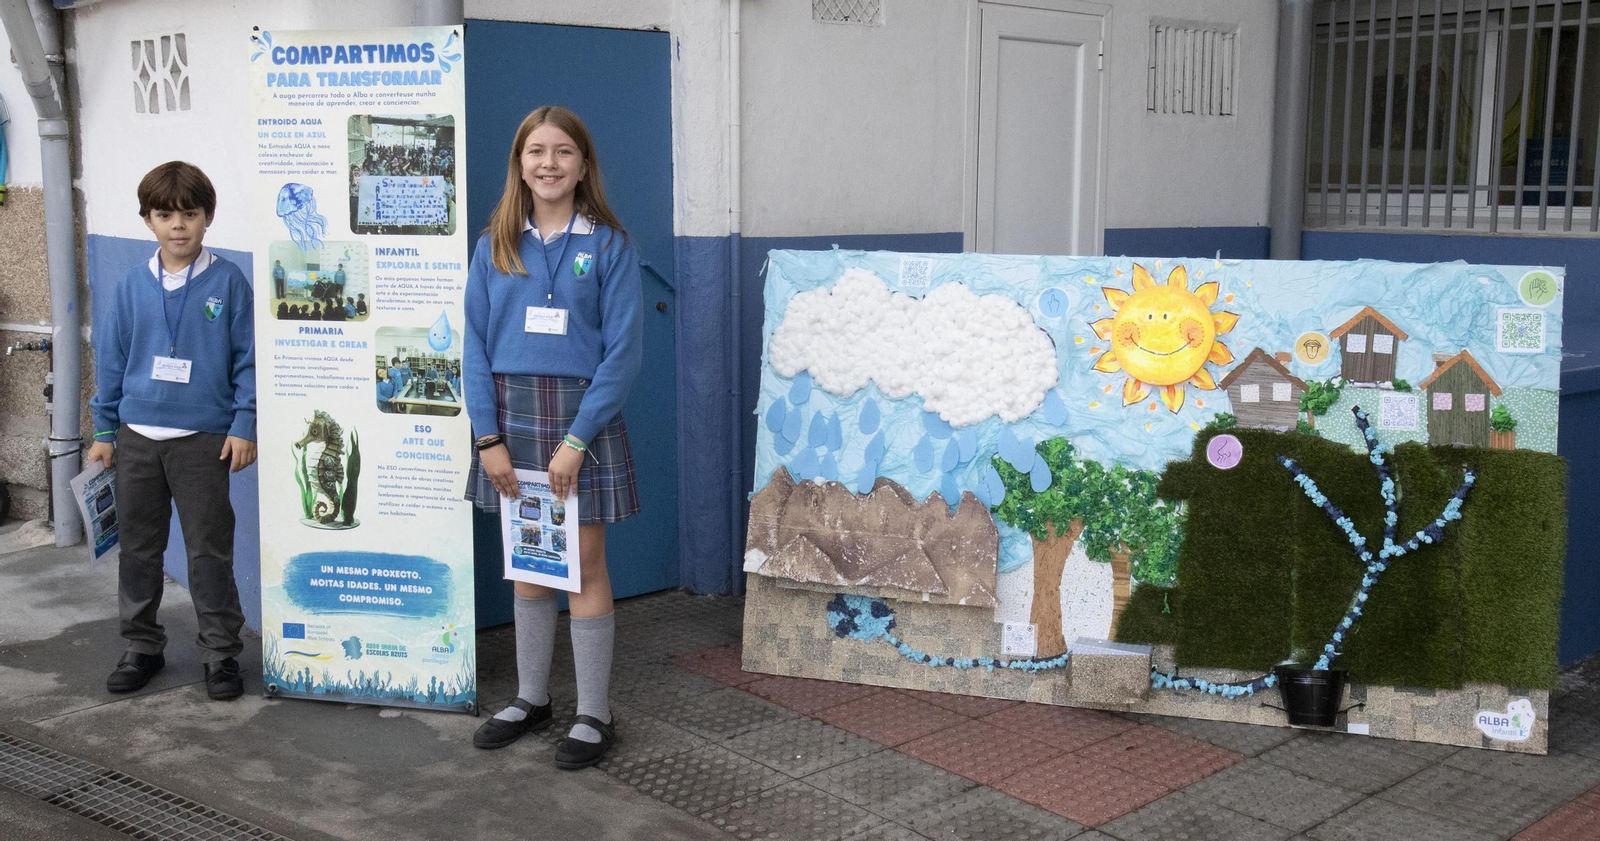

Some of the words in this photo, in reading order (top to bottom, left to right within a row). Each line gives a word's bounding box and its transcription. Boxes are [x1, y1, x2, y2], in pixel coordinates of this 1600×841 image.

[272, 42, 435, 65] COMPARTIMOS
[267, 72, 312, 87] PARA
[317, 70, 442, 86] TRANSFORMAR
[375, 248, 419, 256] INFANTIL
[299, 327, 343, 335] PRIMARIA
[275, 339, 328, 347] INVESTIGAR
[396, 451, 451, 461] CONCIENCIA
[321, 565, 333, 573] UN
[336, 566, 368, 576] MESMO
[372, 568, 421, 579] PROXECTO.
[310, 579, 344, 588] MOITAS
[347, 581, 381, 591] IDADES.
[400, 585, 432, 594] MESMO
[339, 594, 404, 606] COMPROMISO.
[1479, 716, 1509, 727] ALBA
